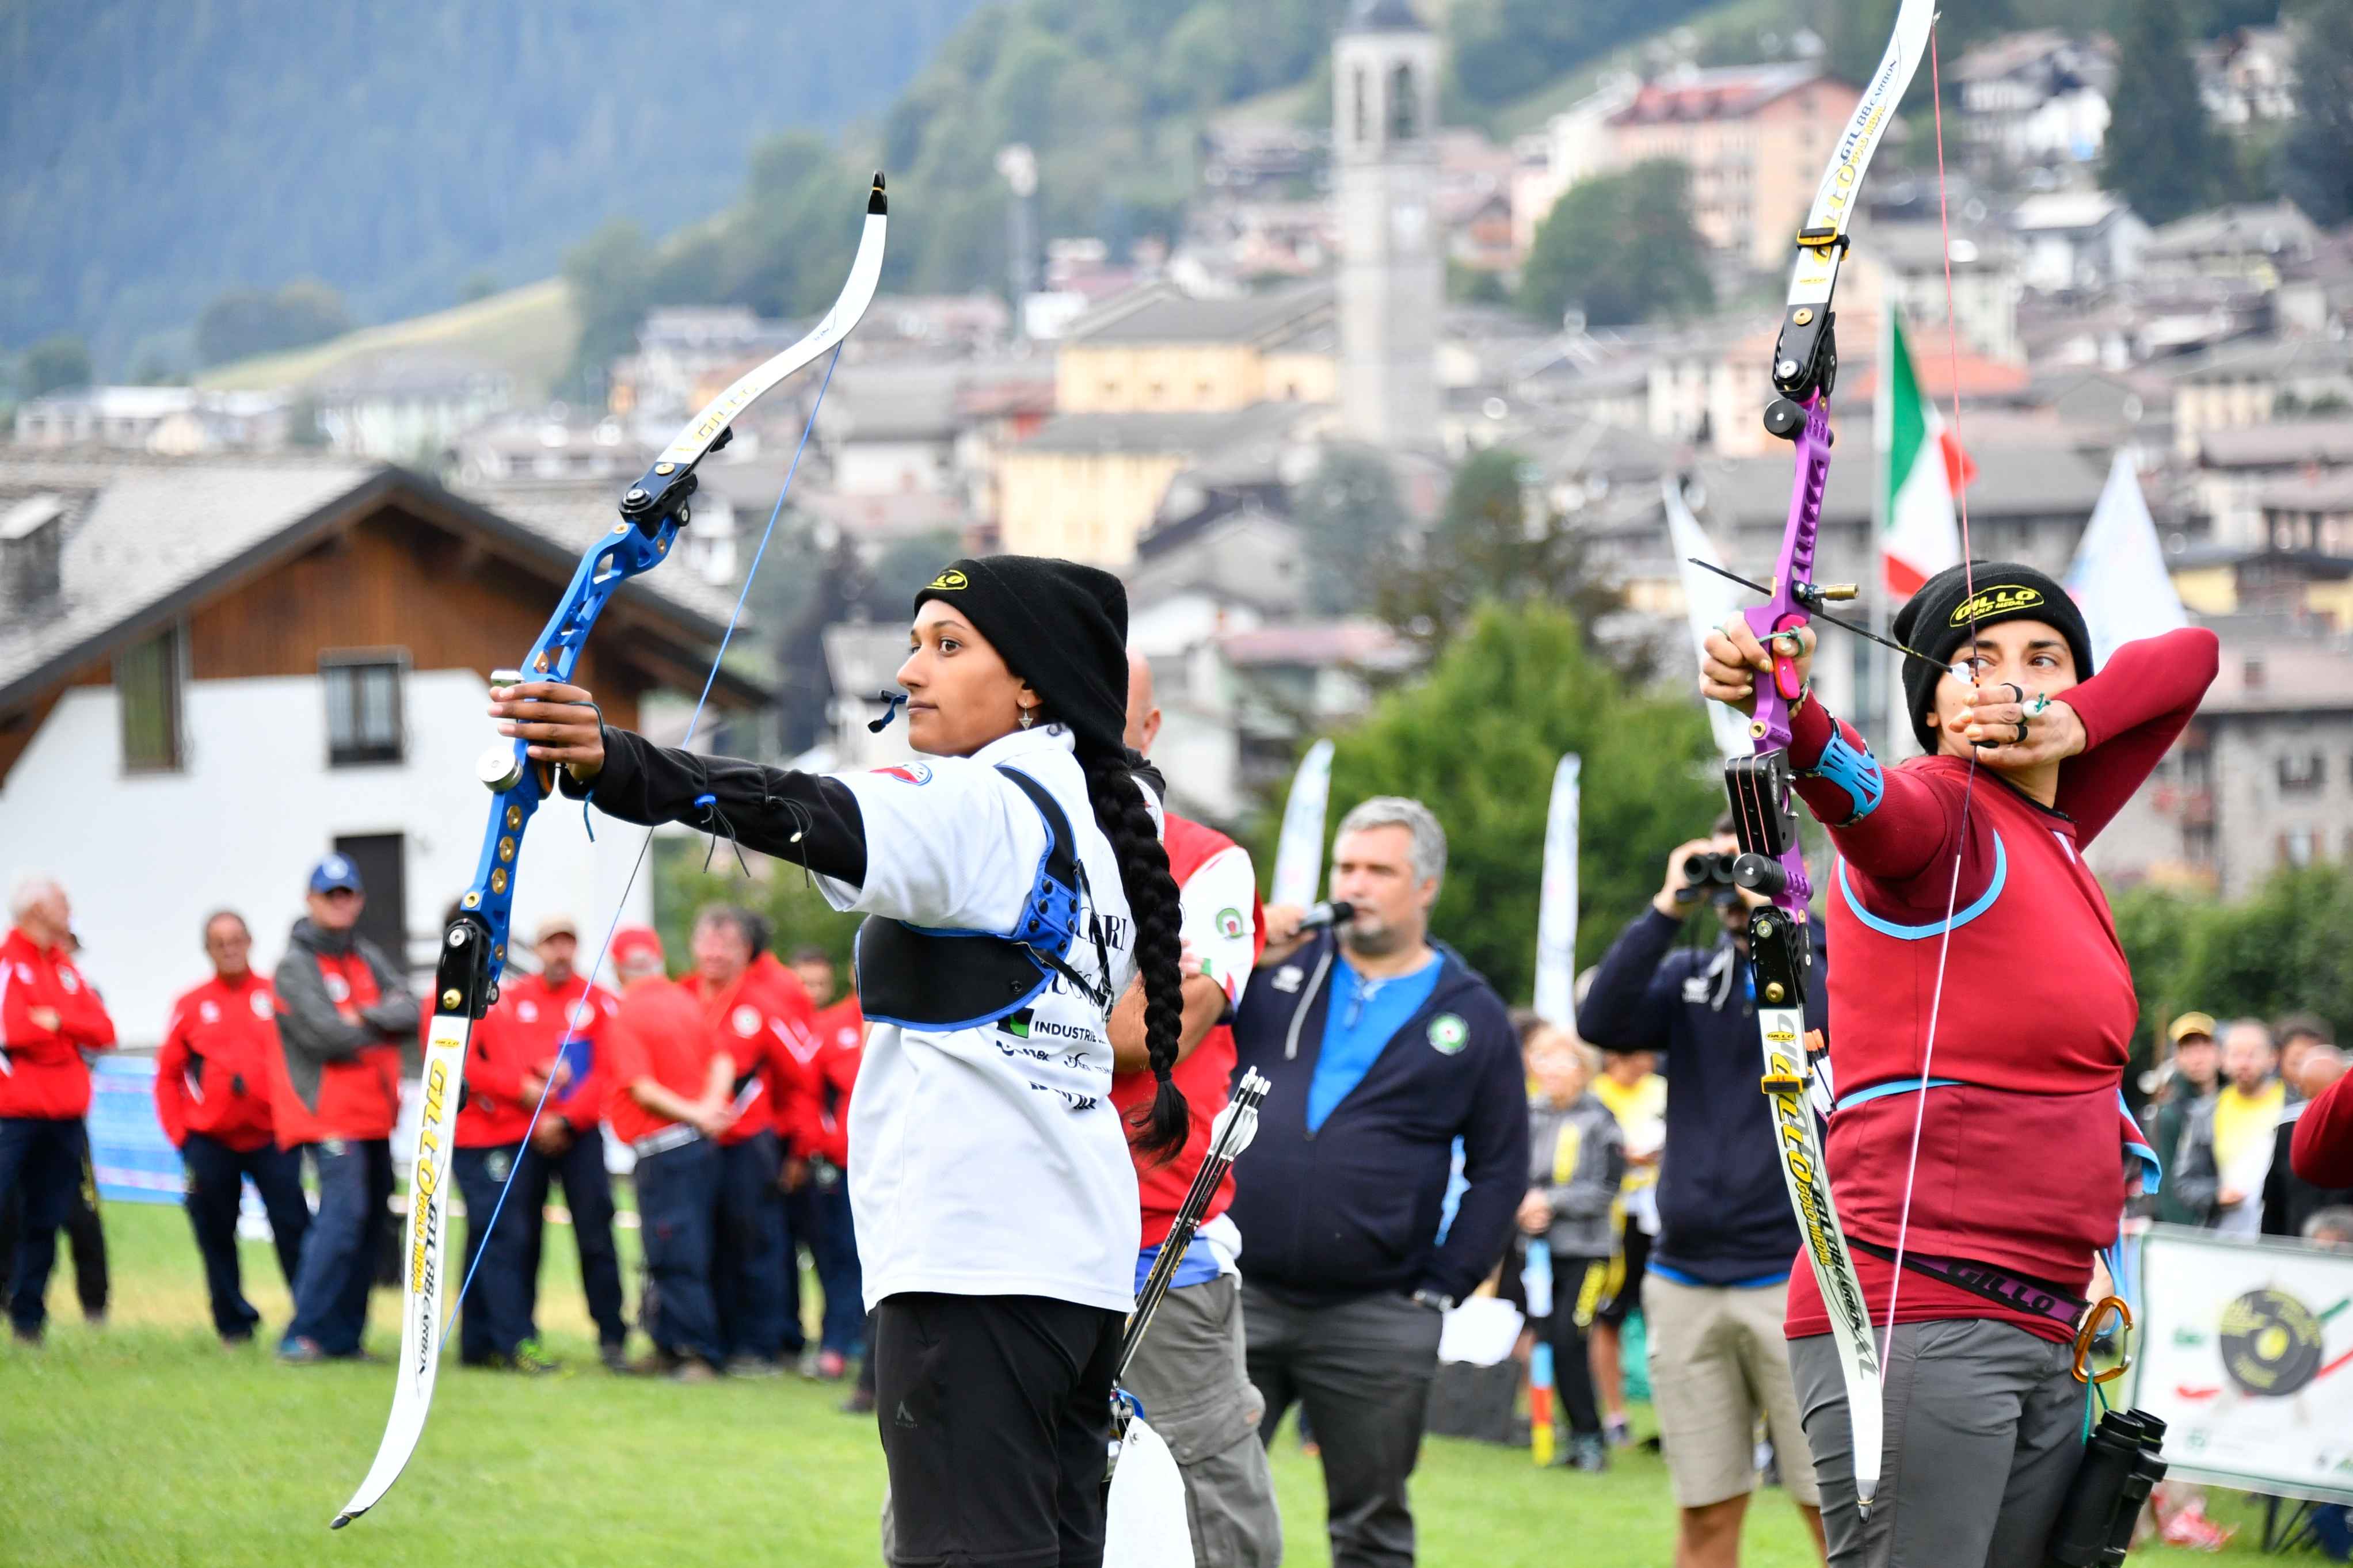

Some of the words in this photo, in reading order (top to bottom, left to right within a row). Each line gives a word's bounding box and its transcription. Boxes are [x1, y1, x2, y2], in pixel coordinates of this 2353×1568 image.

[1841, 131, 1861, 161] GTL
[1857, 106, 1872, 126] 88
[1813, 165, 1856, 267] GLLO
[1955, 590, 2036, 621] GILLO
[1995, 600, 2025, 609] MEDAL
[416, 1058, 448, 1196] GILLO
[415, 1192, 428, 1239] GOLD
[425, 1203, 437, 1255] GTL
[1795, 1181, 1818, 1222] GOLD
[1807, 1221, 1834, 1267] MEDAL
[411, 1239, 425, 1295] MEDAL
[424, 1259, 435, 1298] 88
[1948, 1264, 2055, 1312] GILLO
